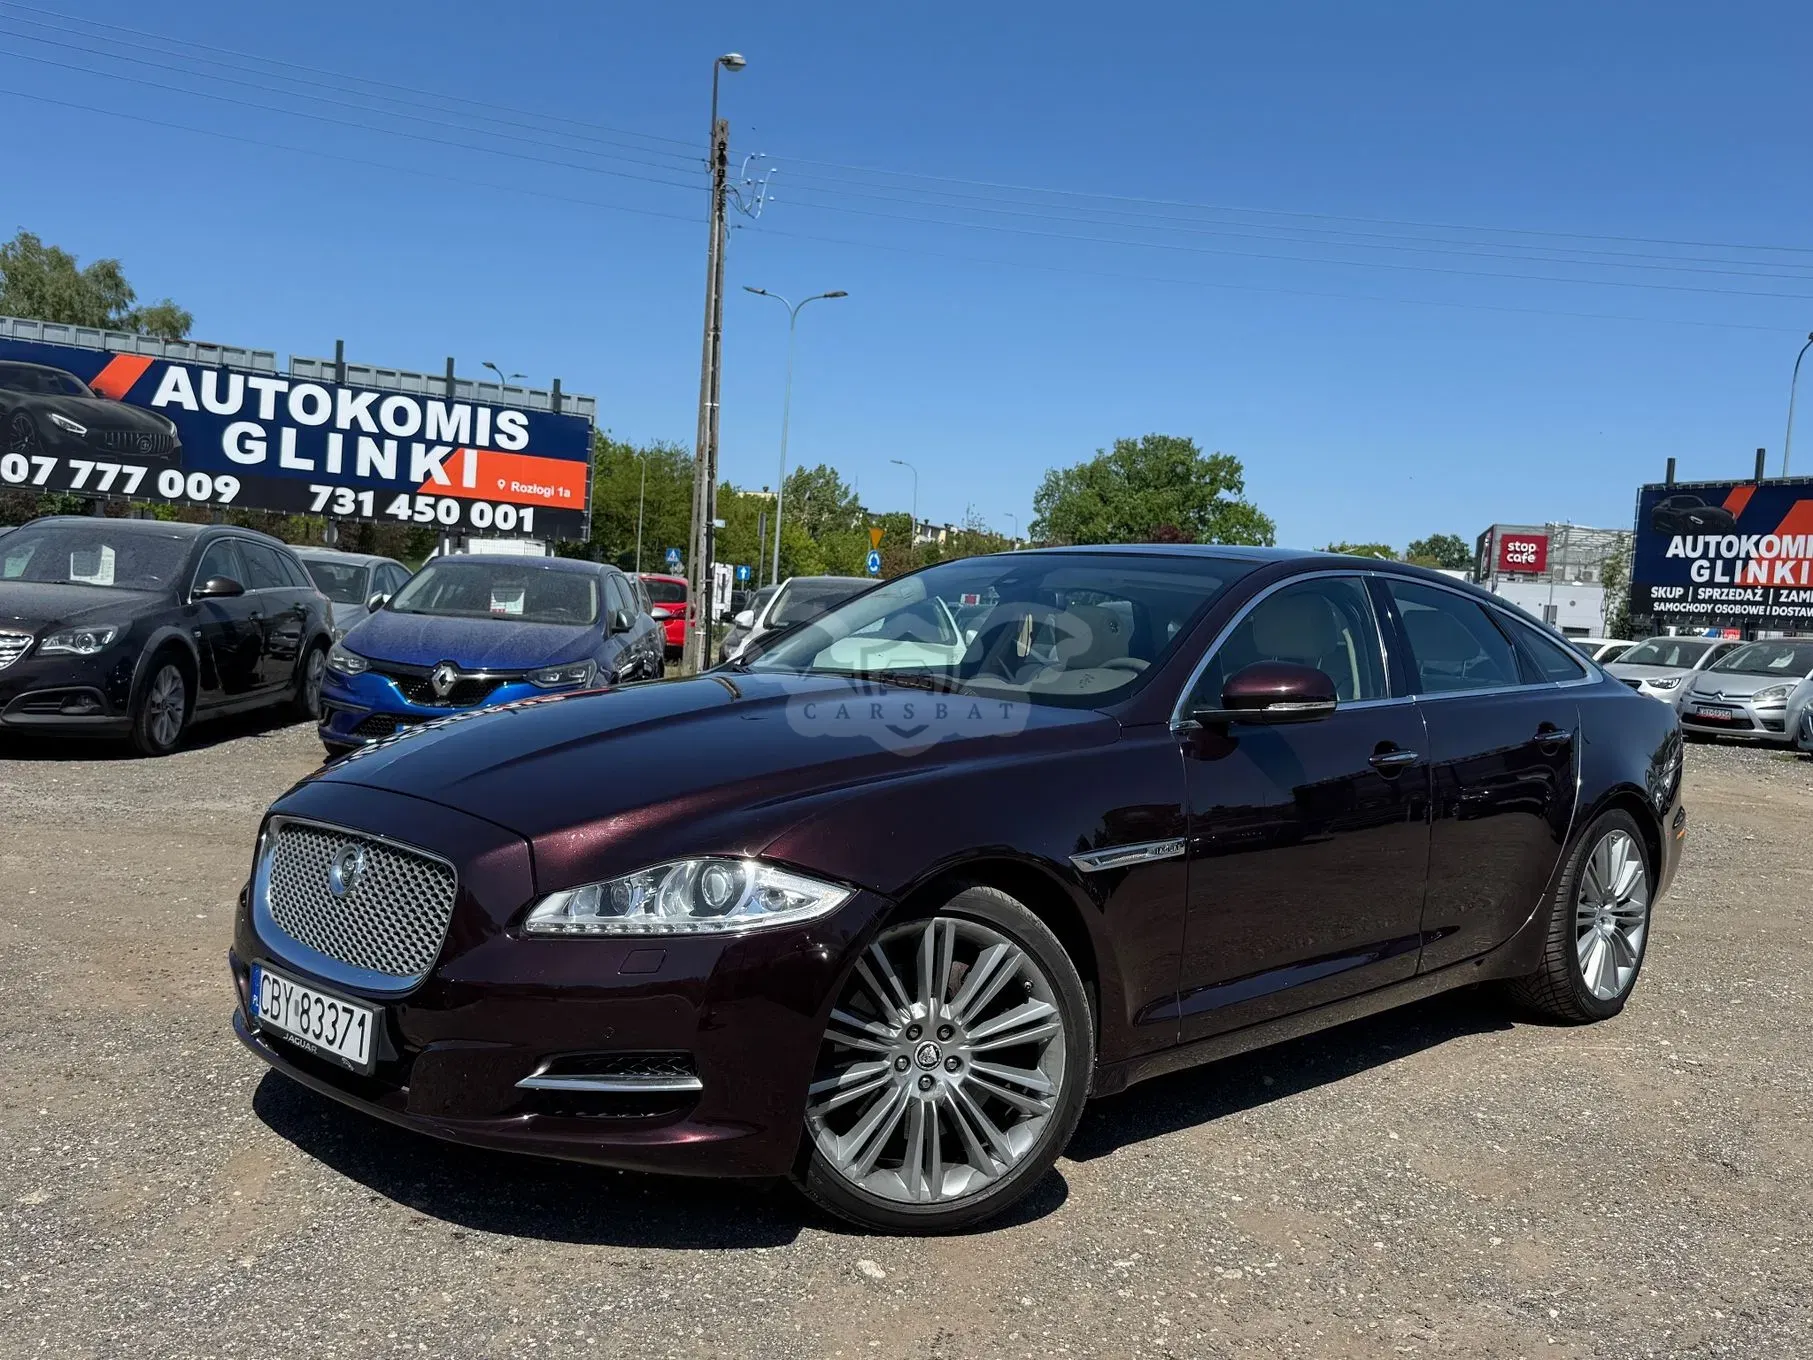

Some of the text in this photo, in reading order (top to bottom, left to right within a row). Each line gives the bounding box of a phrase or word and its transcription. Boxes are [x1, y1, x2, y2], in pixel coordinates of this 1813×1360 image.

[151, 365, 529, 450] AUTOKOMIS
[222, 421, 478, 488] GLINKI
[69, 459, 148, 494] 777
[158, 469, 241, 503] 009
[557, 487, 571, 498] 1a
[309, 484, 535, 532] 731 450 001
[1506, 552, 1536, 564] cafe
[1507, 541, 1536, 554] stop
[1690, 559, 1809, 584] GLINKI
[1650, 586, 1684, 599] SKUP
[1698, 586, 1763, 601] SPRZEDAŻ
[1653, 602, 1714, 614] SAMOCHODY
[1714, 604, 1765, 616] OSOBOWE
[260, 974, 366, 1058] CBY 83371
[282, 1033, 317, 1055] JAGUAR
